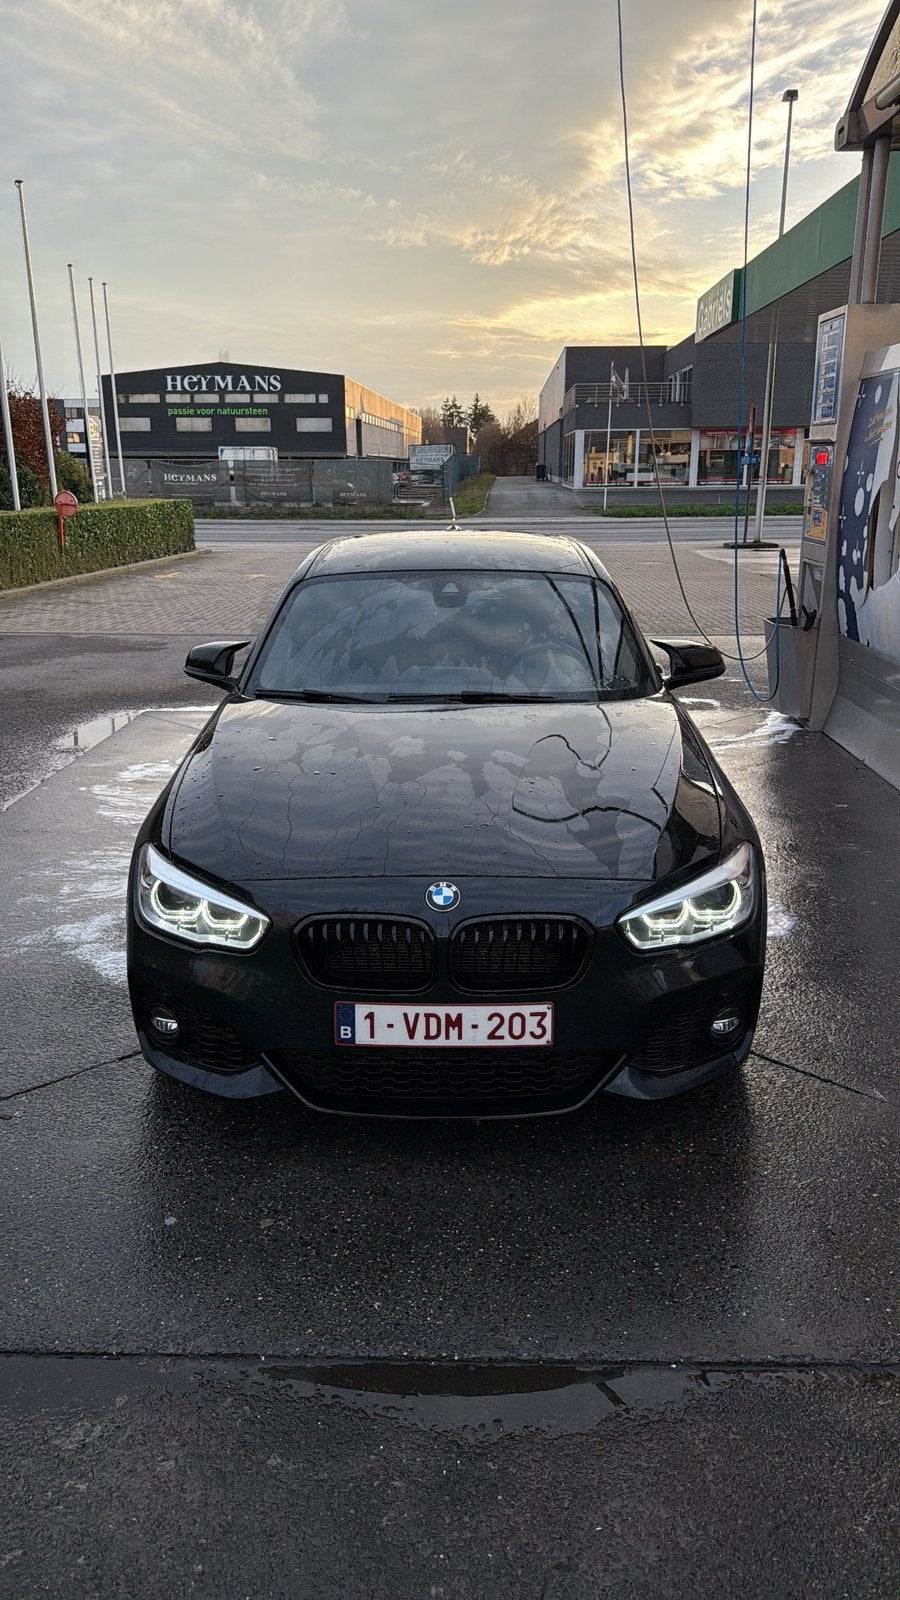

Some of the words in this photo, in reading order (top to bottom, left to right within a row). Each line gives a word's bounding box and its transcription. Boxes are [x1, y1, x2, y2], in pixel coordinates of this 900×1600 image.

[698, 283, 732, 335] Gabriels
[168, 407, 195, 415] passie
[217, 407, 268, 415] natuursteen
[340, 1026, 352, 1039] B
